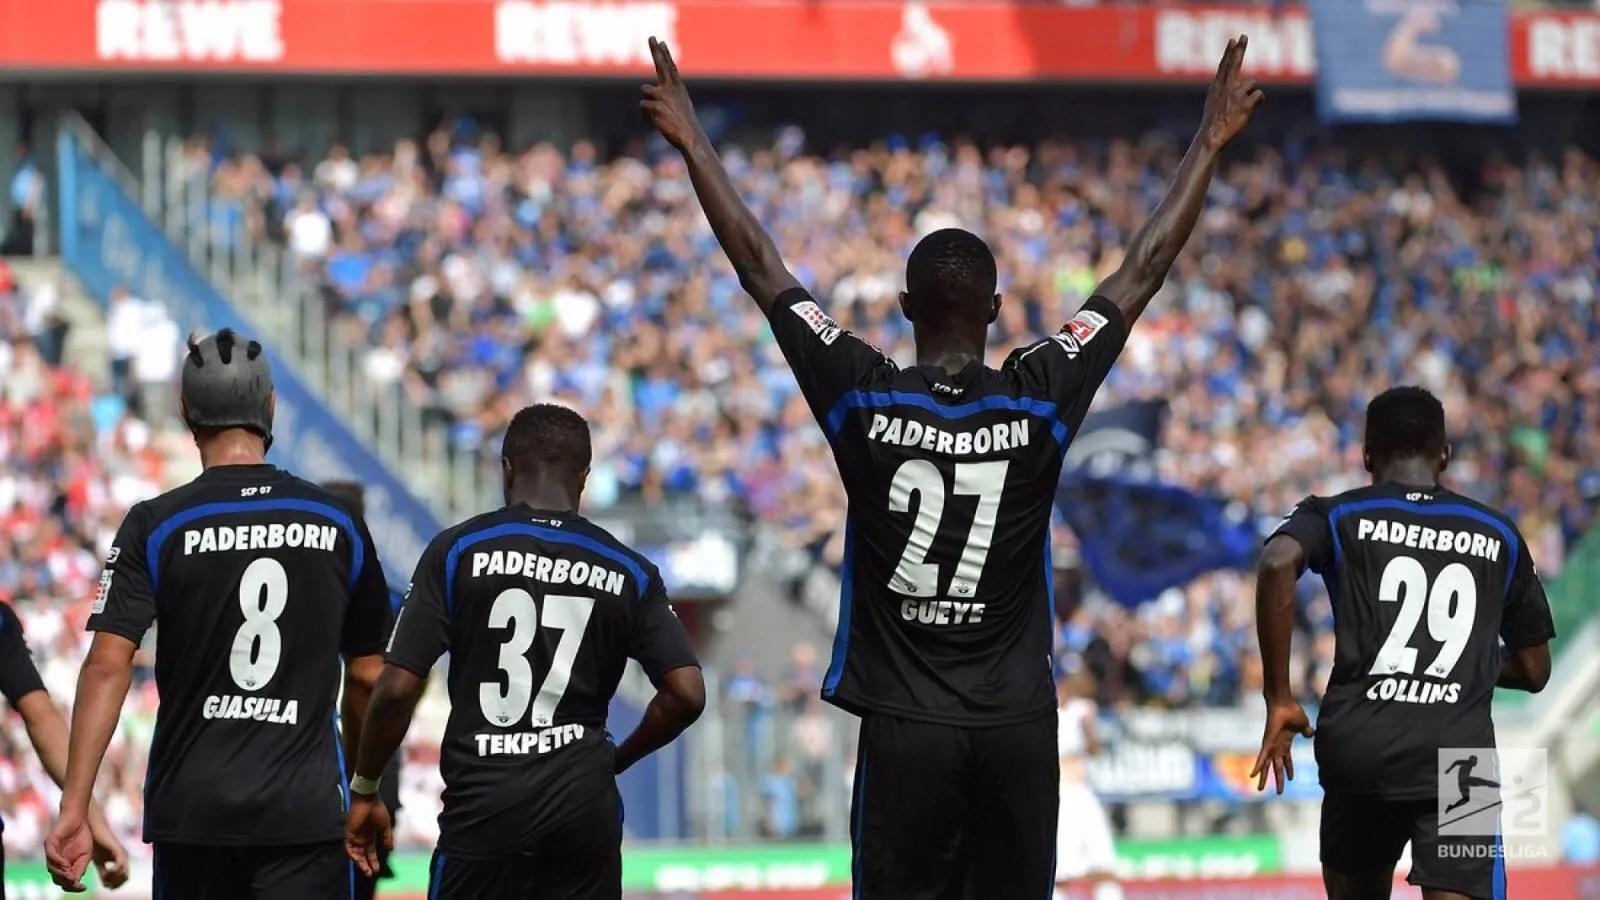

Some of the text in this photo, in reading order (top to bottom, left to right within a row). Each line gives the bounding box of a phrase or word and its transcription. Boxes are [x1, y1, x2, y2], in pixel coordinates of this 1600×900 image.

[96, 0, 284, 61] REWE
[494, 2, 680, 65] REWE
[867, 413, 1029, 455] PADERBORN
[240, 485, 272, 497] SCP 07
[183, 522, 338, 556] PADERBORN
[887, 459, 1010, 598] 27
[1357, 518, 1501, 562] PADERBORN
[472, 550, 625, 596] PADERBORN
[229, 557, 289, 692] 8
[901, 600, 986, 625] GUEYE
[1368, 555, 1477, 679] 29
[479, 587, 596, 728] 37
[202, 694, 299, 725] GJASULA
[1366, 676, 1462, 704] COLLINS
